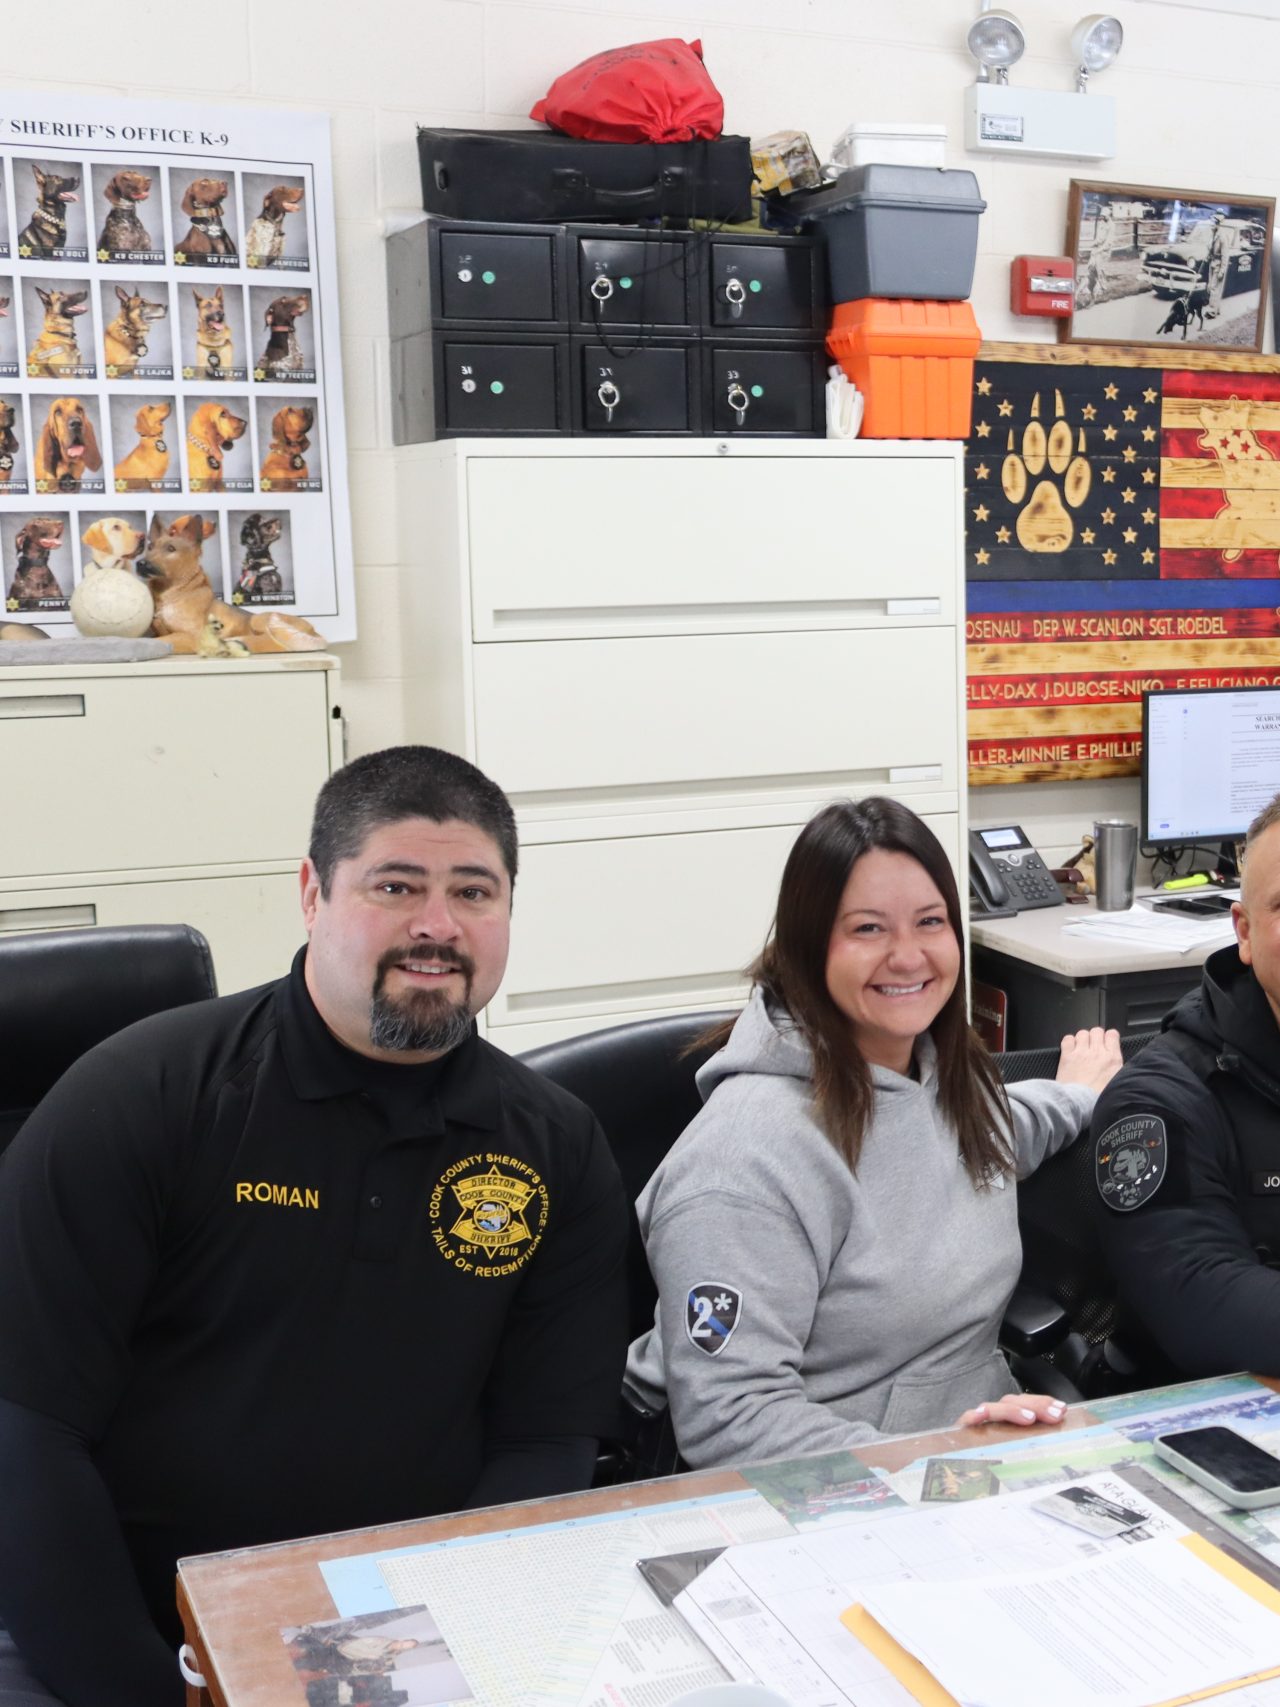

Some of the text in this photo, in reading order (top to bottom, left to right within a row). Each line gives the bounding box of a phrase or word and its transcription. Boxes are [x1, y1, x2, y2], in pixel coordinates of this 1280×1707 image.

[10, 119, 116, 139] SHERIFF'S
[121, 126, 194, 144] OFFICE
[200, 131, 229, 146] K-9
[128, 253, 164, 261] CHESTER
[1052, 300, 1069, 309] FIRE
[1080, 618, 1144, 635] SCANLON
[1177, 617, 1228, 635] ROEDEL
[1101, 1120, 1157, 1146] COOK COUNTY
[1111, 1130, 1144, 1148] SHERIFF
[429, 1153, 549, 1227] COOK COUNTY SHERIFF'S OFFICE
[471, 1177, 516, 1188] DIRECTOR
[236, 1182, 319, 1209] ROMAN
[460, 1190, 525, 1205] COOK COUNTY
[431, 1226, 542, 1278] TAILS OF REDEMPTION
[460, 1245, 479, 1254] EST
